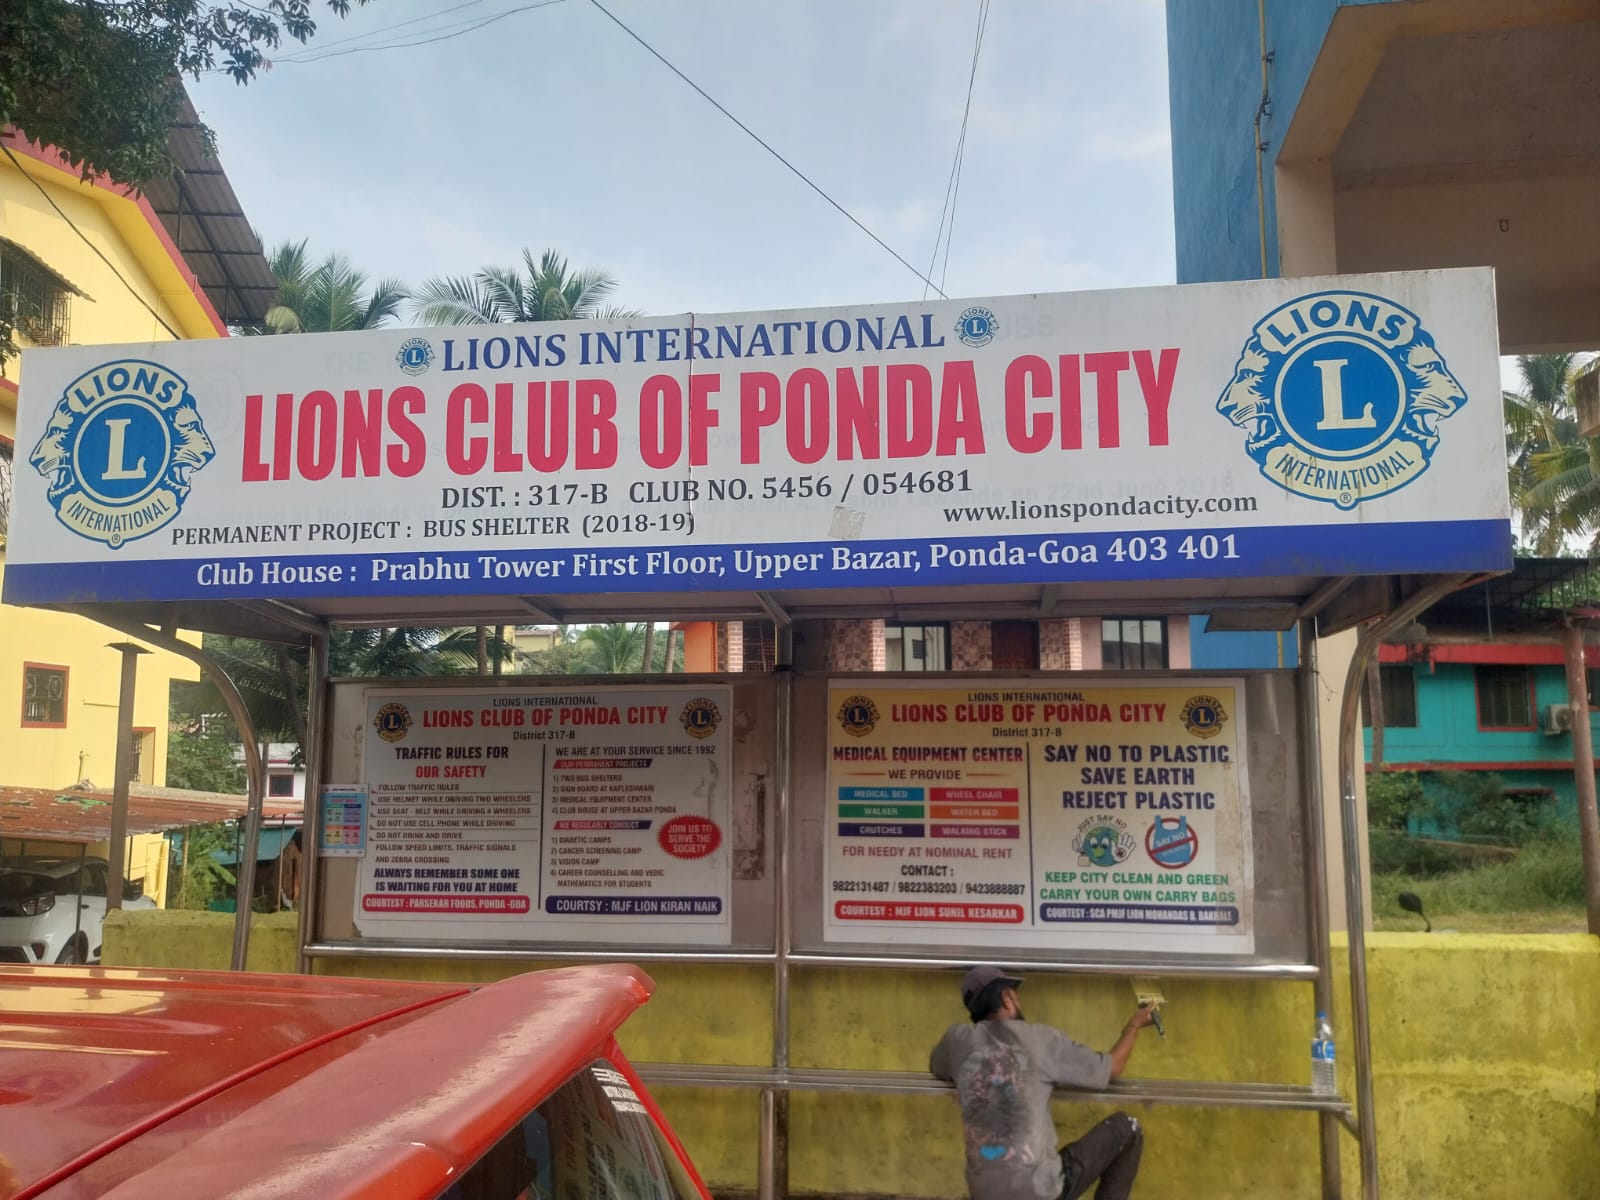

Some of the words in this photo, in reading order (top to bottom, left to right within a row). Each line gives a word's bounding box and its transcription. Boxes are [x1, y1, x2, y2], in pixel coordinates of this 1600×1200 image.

[963, 308, 991, 320] LIONS
[1267, 300, 1406, 349] LIONS
[404, 338, 429, 350] LIONS
[442, 334, 566, 371] LIONS
[580, 313, 945, 365] INTERNATIONAL
[74, 368, 178, 409] LIONS
[1313, 359, 1377, 430] L
[242, 385, 427, 482] LIONS
[446, 379, 618, 475] CLUB
[639, 374, 720, 470] OF
[740, 360, 986, 464] PONDA
[1005, 348, 1181, 454] CITY
[101, 419, 147, 480] L
[1275, 450, 1414, 491] INTERNATIONAL
[441, 486, 506, 509] DIST.
[528, 484, 608, 506] 317-B
[629, 480, 699, 504] CLUB
[708, 478, 754, 500] NO.
[762, 476, 832, 500] 5456
[862, 469, 972, 496] 054681
[67, 499, 171, 532] INTERNATIONAL
[944, 495, 1257, 523] www.lionspondacity.com
[172, 524, 302, 546] PERMANENT
[308, 521, 400, 542] PROJECT
[424, 520, 465, 538] BUS
[472, 515, 570, 536] SHELTER
[582, 512, 694, 538] (2018-19)
[197, 562, 254, 587] Club
[261, 561, 342, 584] House
[371, 557, 470, 582] Prabhu
[479, 556, 564, 579] Tower
[572, 554, 638, 577] First
[646, 552, 726, 578] Floor,
[734, 550, 823, 578] Upper
[832, 547, 920, 572] Bazar,
[930, 541, 1098, 568] Ponda-Goa
[1107, 536, 1167, 562] 403
[1177, 534, 1240, 560] 401
[493, 698, 520, 707] LIONS
[524, 696, 598, 706] INTERNATIONAL
[968, 692, 998, 702] LIONS
[1002, 692, 1084, 702] INTERNATIONAL
[423, 710, 474, 728] LIONS
[480, 709, 524, 727] CLUB
[531, 708, 553, 726] OF
[560, 706, 621, 725] PONDA
[628, 705, 669, 724] CITY
[892, 704, 947, 722] LIONS
[955, 704, 1004, 722] CLUB
[1012, 704, 1036, 722] OF
[1044, 704, 1112, 722] PONDA
[1120, 704, 1166, 722] CITY
[513, 731, 546, 740] District
[548, 730, 575, 740] 317-B
[992, 728, 1028, 737] District
[1031, 728, 1062, 737] 317-B
[395, 747, 442, 760] TRAFFIC
[445, 747, 481, 759] RULES
[486, 746, 509, 759] FOR
[555, 747, 569, 756] WE
[571, 747, 587, 756] ARE
[589, 746, 600, 755] AT
[603, 746, 626, 755] YOUR
[628, 746, 665, 755] SERVICE
[666, 745, 692, 755] SINCE
[695, 745, 715, 754] 1992
[833, 747, 887, 761] MEDICAL
[892, 747, 967, 763] EQUIPMENT
[972, 747, 1024, 762] CENTER
[1044, 745, 1078, 762] SAY
[1085, 745, 1111, 762] NO
[1118, 745, 1142, 762] TO
[1150, 745, 1229, 763] PLASTIC
[415, 766, 439, 778] OUR
[443, 765, 486, 778] SAFETY
[888, 769, 906, 779] WE
[910, 769, 961, 780] PROVIDE
[1081, 768, 1126, 785] SAVE
[1134, 768, 1195, 785] EARTH
[854, 790, 890, 798] MEDICAL
[891, 790, 908, 798] BED
[1062, 791, 1127, 809] REJECT
[1135, 791, 1215, 810] PLASTIC
[864, 807, 898, 815] WALKER
[668, 824, 686, 833] JOIN
[688, 824, 700, 833] US
[702, 824, 712, 833] TO
[1077, 817, 1095, 833] JUST
[1096, 814, 1114, 822] SAY
[1114, 819, 1127, 829] NO
[668, 834, 694, 843] SERVE
[696, 834, 712, 843] THE
[673, 844, 706, 853] SOCIETY
[842, 846, 865, 856] FOR
[868, 846, 905, 857] NEEDY
[908, 847, 922, 857] AT
[925, 847, 979, 858] NOMINAL
[982, 848, 1013, 859] RENT
[374, 868, 412, 879] ALWAYS
[414, 868, 468, 879] REMEMBER
[470, 868, 498, 879] SOME
[500, 868, 520, 878] ONE
[901, 865, 947, 876] CONTACT
[1045, 872, 1077, 883] KEEP
[1080, 872, 1109, 883] CITY
[1112, 873, 1153, 884] CLEAN
[1156, 873, 1183, 885] AND
[1186, 874, 1229, 886] GREEN
[375, 881, 385, 892] IS
[387, 881, 430, 892] WAITING
[432, 881, 450, 892] FOR
[453, 882, 473, 892] YOU
[474, 882, 487, 892] AT
[488, 882, 518, 892] HOME
[1040, 888, 1081, 900] CARRY
[1085, 889, 1119, 901] YOUR
[1123, 890, 1152, 901] OWN
[1156, 890, 1197, 902] CARRY
[1202, 891, 1236, 903] BAGS
[556, 899, 601, 911] COURTSY
[611, 900, 632, 911] MJF
[634, 900, 658, 911] LION
[660, 900, 691, 911] KIRAN
[694, 901, 718, 911] NAIK
